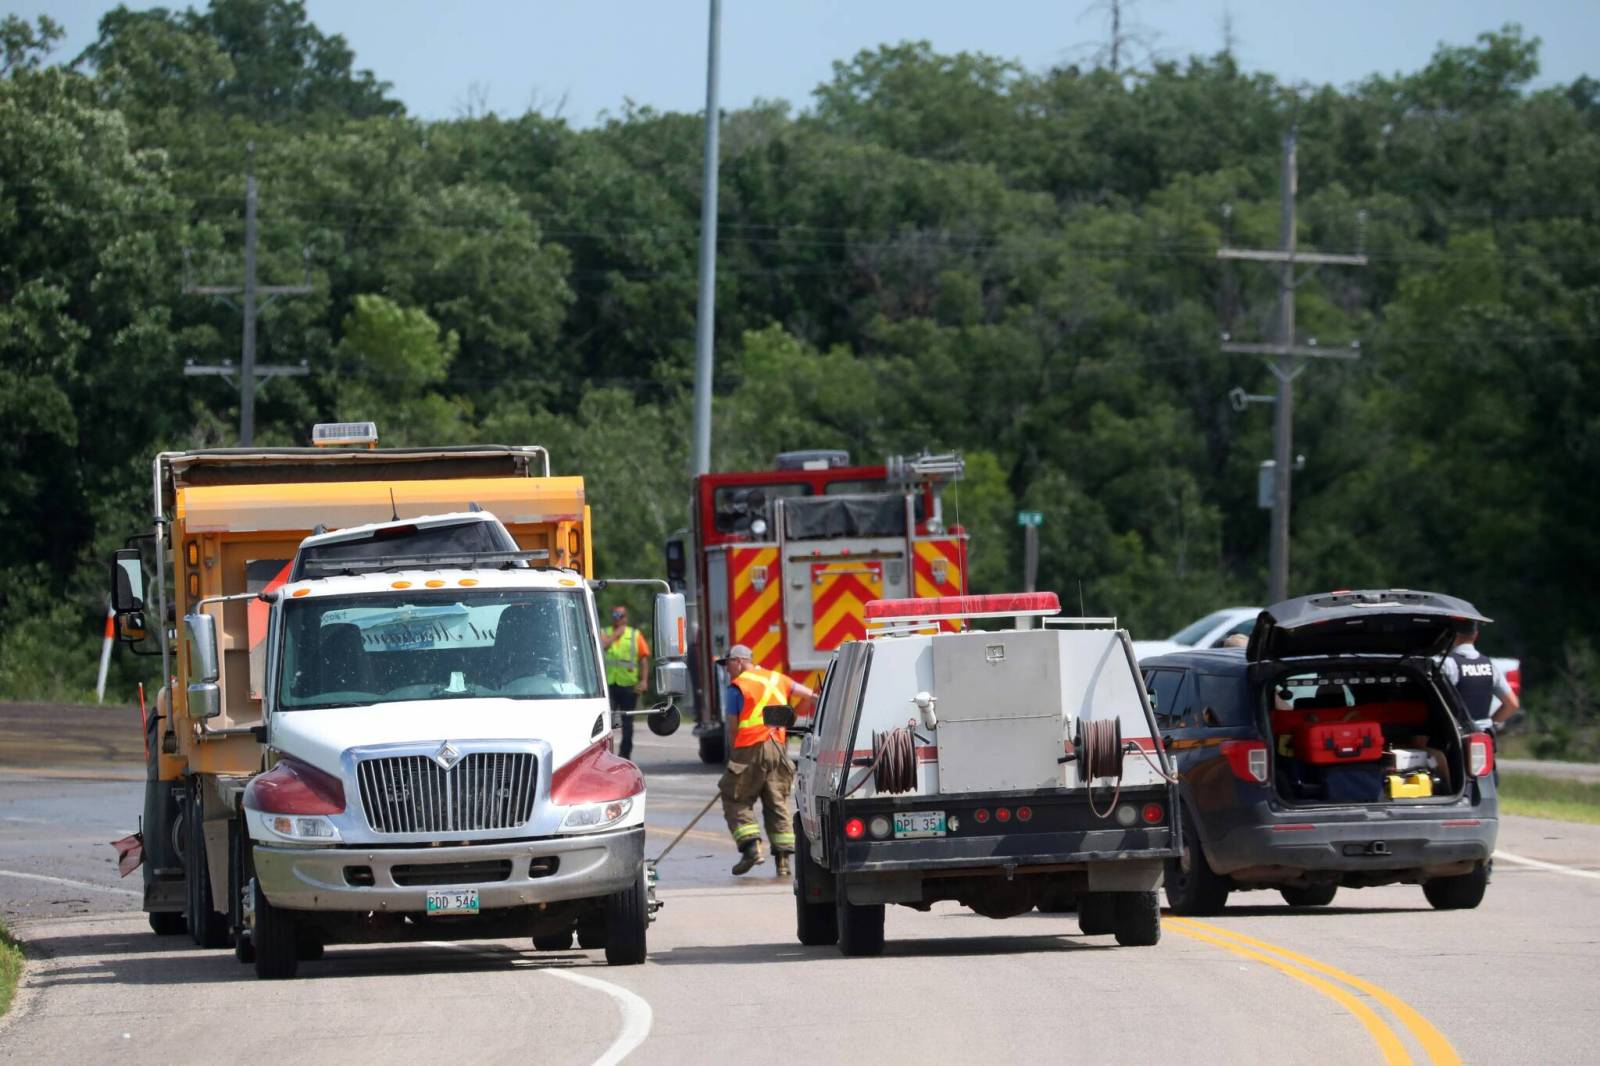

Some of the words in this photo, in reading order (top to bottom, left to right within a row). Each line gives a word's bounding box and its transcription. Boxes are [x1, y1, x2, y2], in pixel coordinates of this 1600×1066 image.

[1462, 664, 1492, 676] POLICE
[896, 819, 918, 832] DPL
[456, 896, 476, 909] 546
